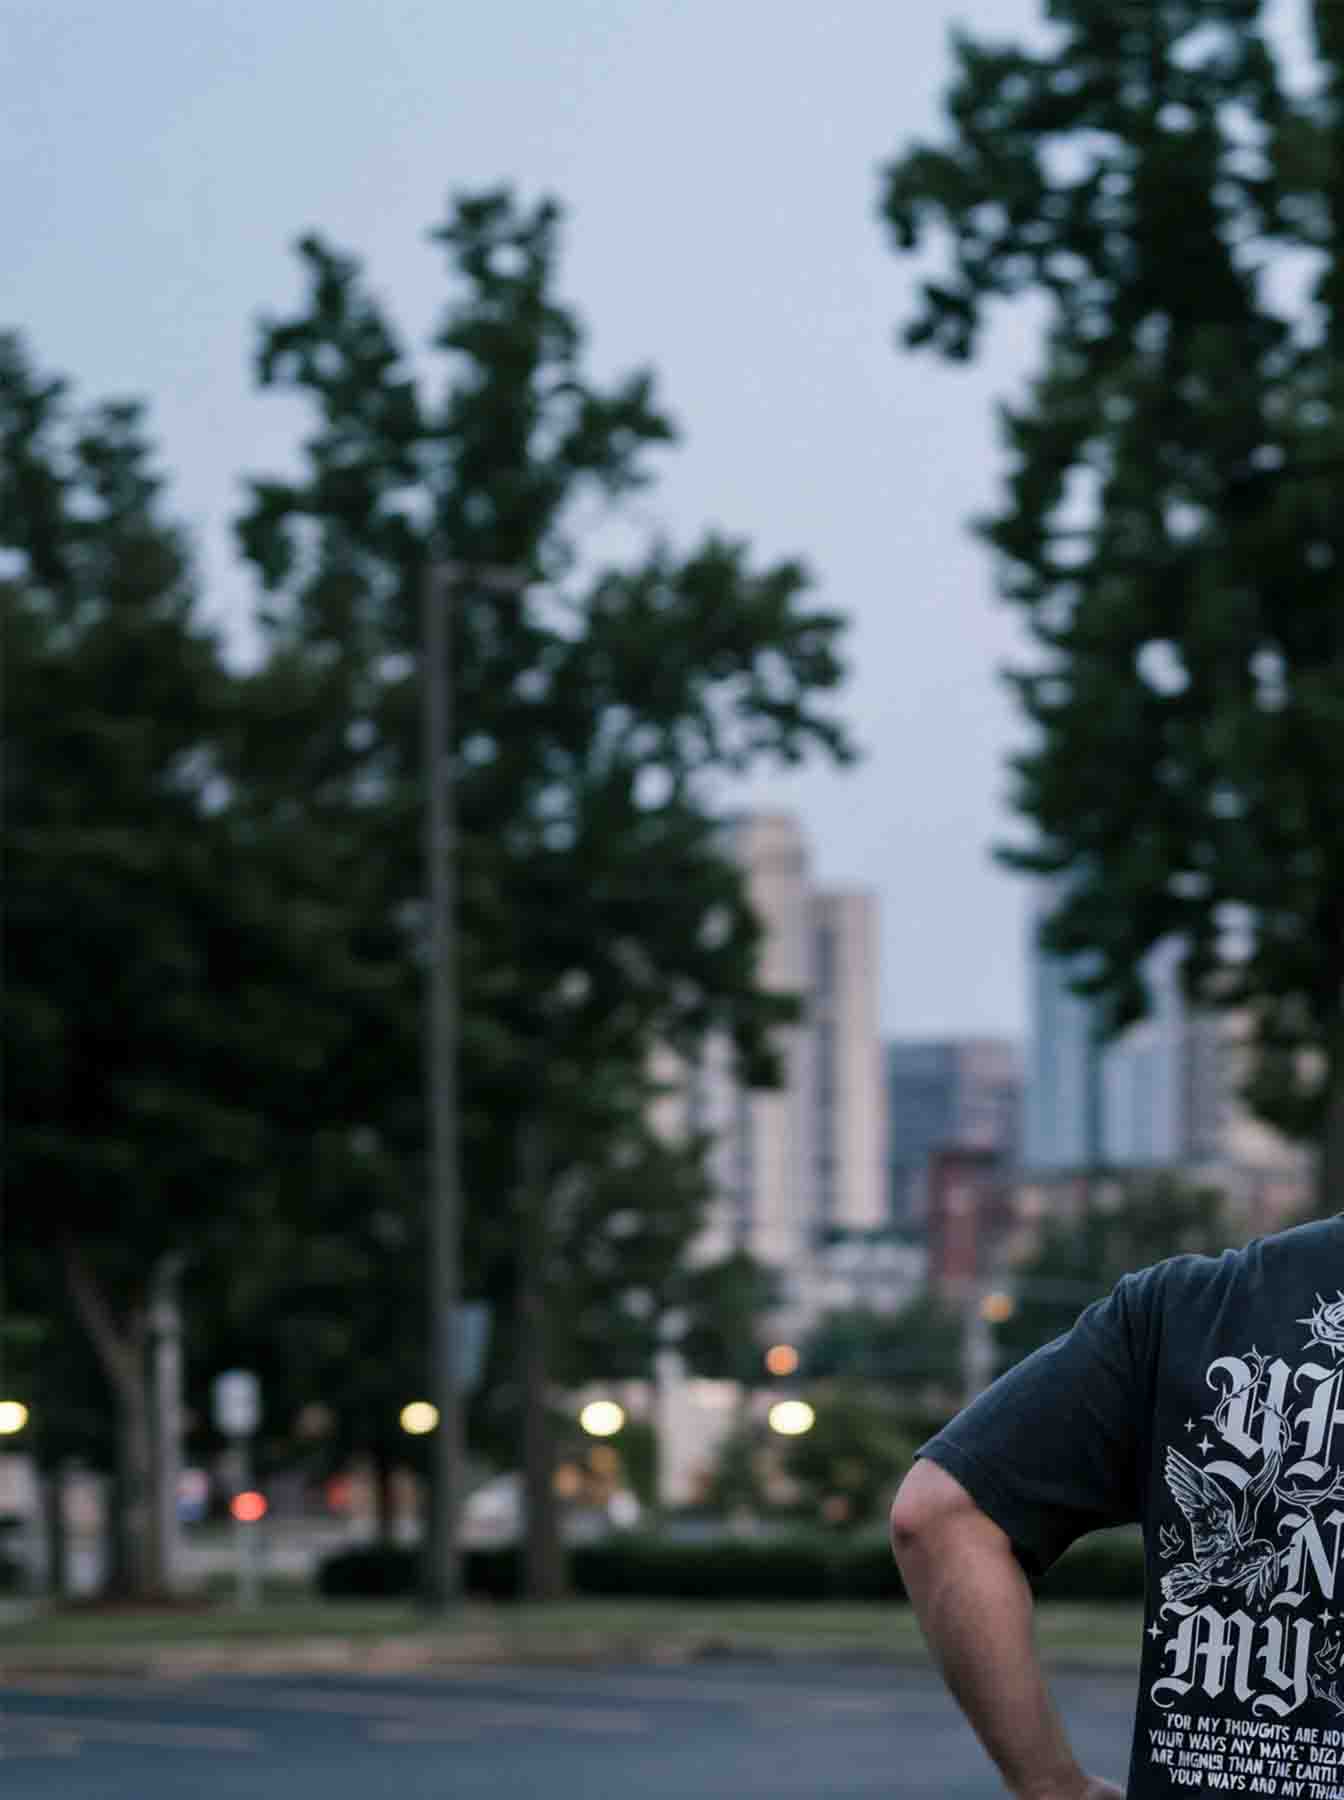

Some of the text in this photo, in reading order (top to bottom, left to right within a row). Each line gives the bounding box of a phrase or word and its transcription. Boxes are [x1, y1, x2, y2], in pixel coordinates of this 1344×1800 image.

[1151, 1599, 1314, 1717] MY
[1197, 1716, 1220, 1733] MY
[1189, 1733, 1227, 1752] WAYS
[1228, 1756, 1263, 1775] THAN
[1207, 1772, 1246, 1791] WAYS
[1281, 1780, 1305, 1798] MY
